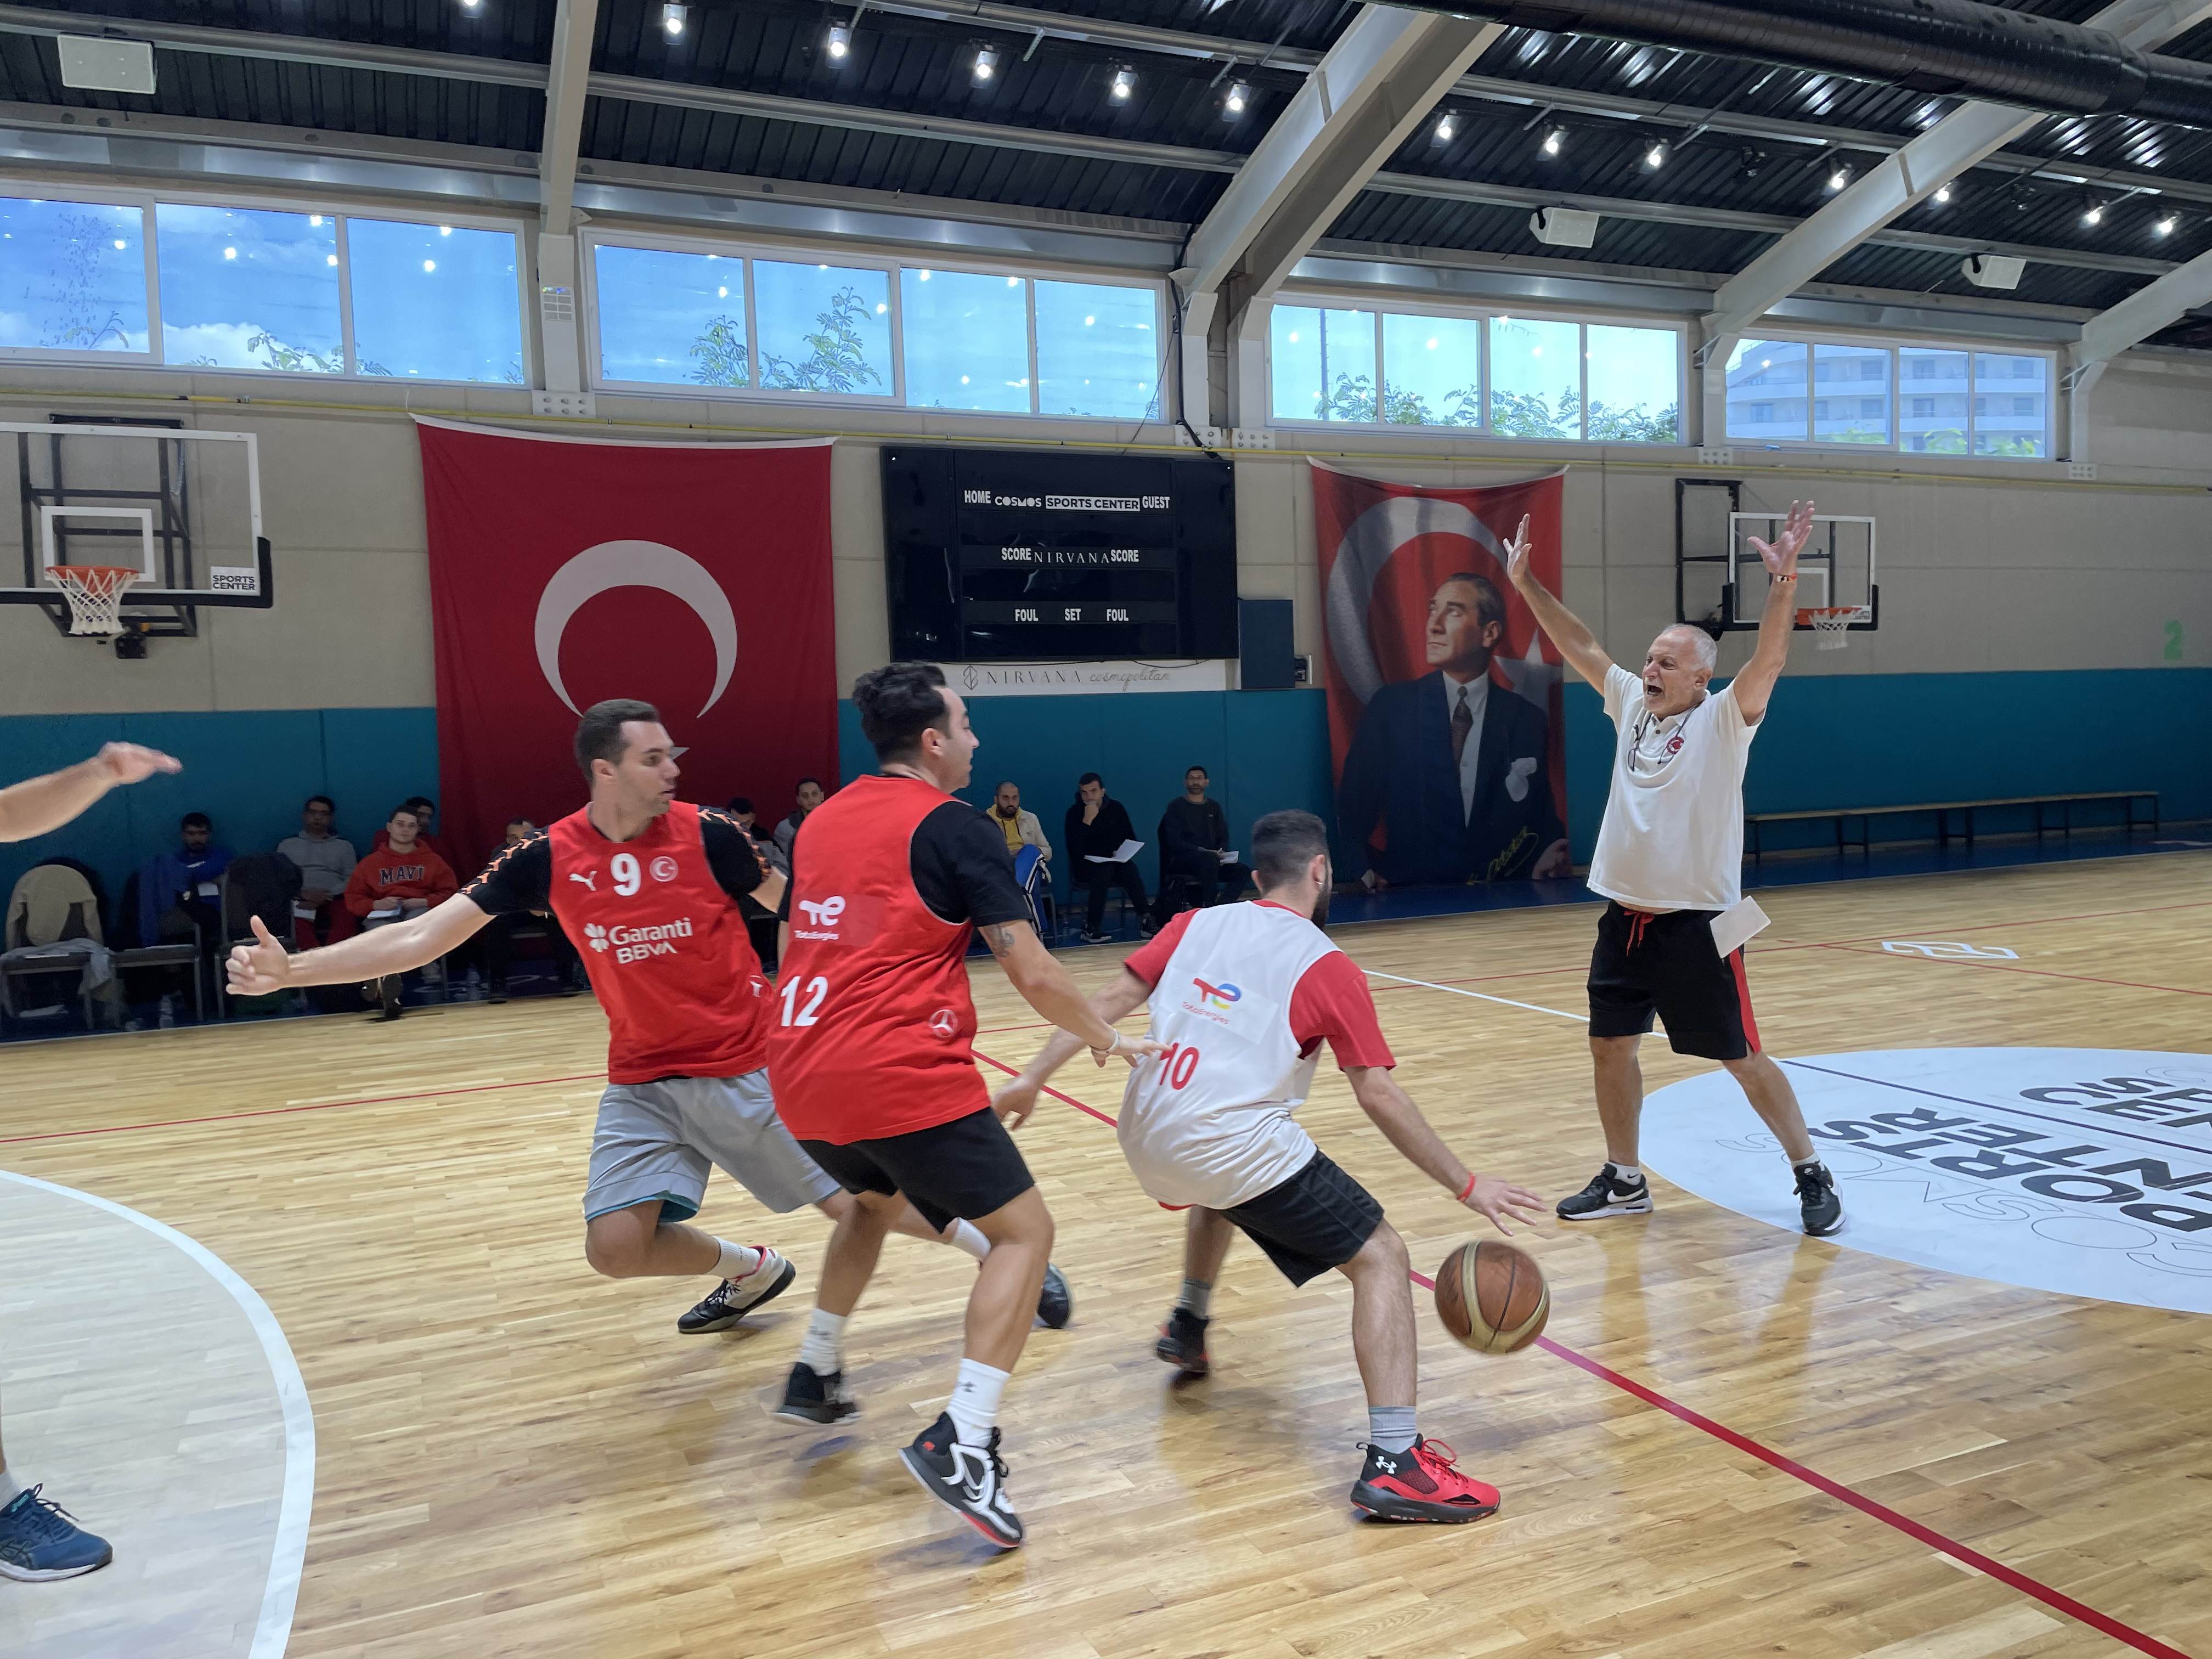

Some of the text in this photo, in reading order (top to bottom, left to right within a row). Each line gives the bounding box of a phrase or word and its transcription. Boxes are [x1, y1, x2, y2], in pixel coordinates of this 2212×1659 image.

[964, 490, 991, 504] HOME
[994, 496, 1139, 510] COSMOS SPORTS CENTER
[1142, 496, 1170, 509] GUEST
[1001, 548, 1032, 561] SCORE
[1034, 551, 1109, 564] NIRVANA
[1110, 549, 1139, 562] SCORE
[212, 575, 255, 583] SPORTS
[212, 582, 255, 590] CENTER
[1014, 608, 1039, 622] FOUL
[1064, 608, 1081, 621] SET
[1106, 608, 1129, 622] FOUL
[987, 670, 1082, 684] NIRVANA
[380, 865, 425, 885] MAVI
[610, 853, 641, 896] 9
[608, 917, 693, 945] Garanti
[616, 940, 678, 964] BBVA
[780, 975, 828, 1027] 12
[1159, 1042, 1199, 1091] 10
[1807, 1120, 2212, 1233] PORTS
